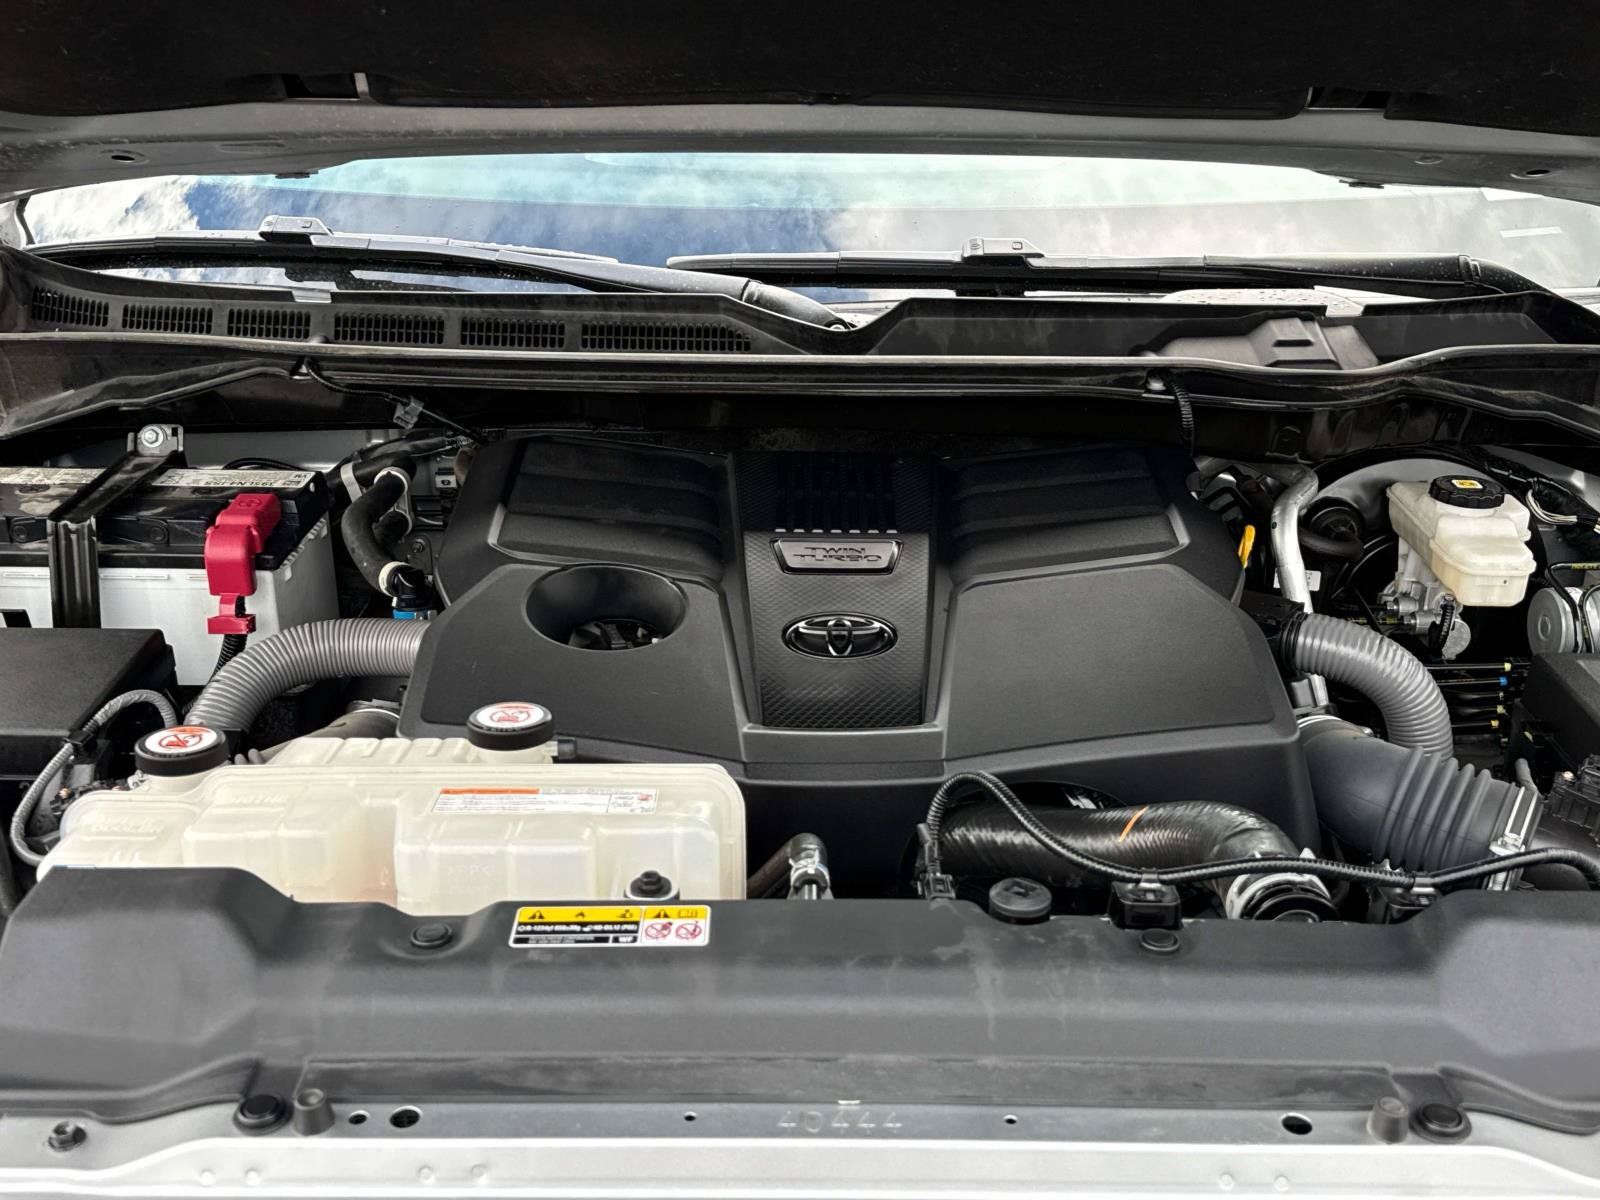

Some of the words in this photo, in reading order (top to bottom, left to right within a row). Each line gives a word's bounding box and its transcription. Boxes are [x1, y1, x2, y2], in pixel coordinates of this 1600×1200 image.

[804, 546, 866, 554] TWIN
[793, 553, 882, 562] TURBO
[778, 1108, 902, 1135] 40444
